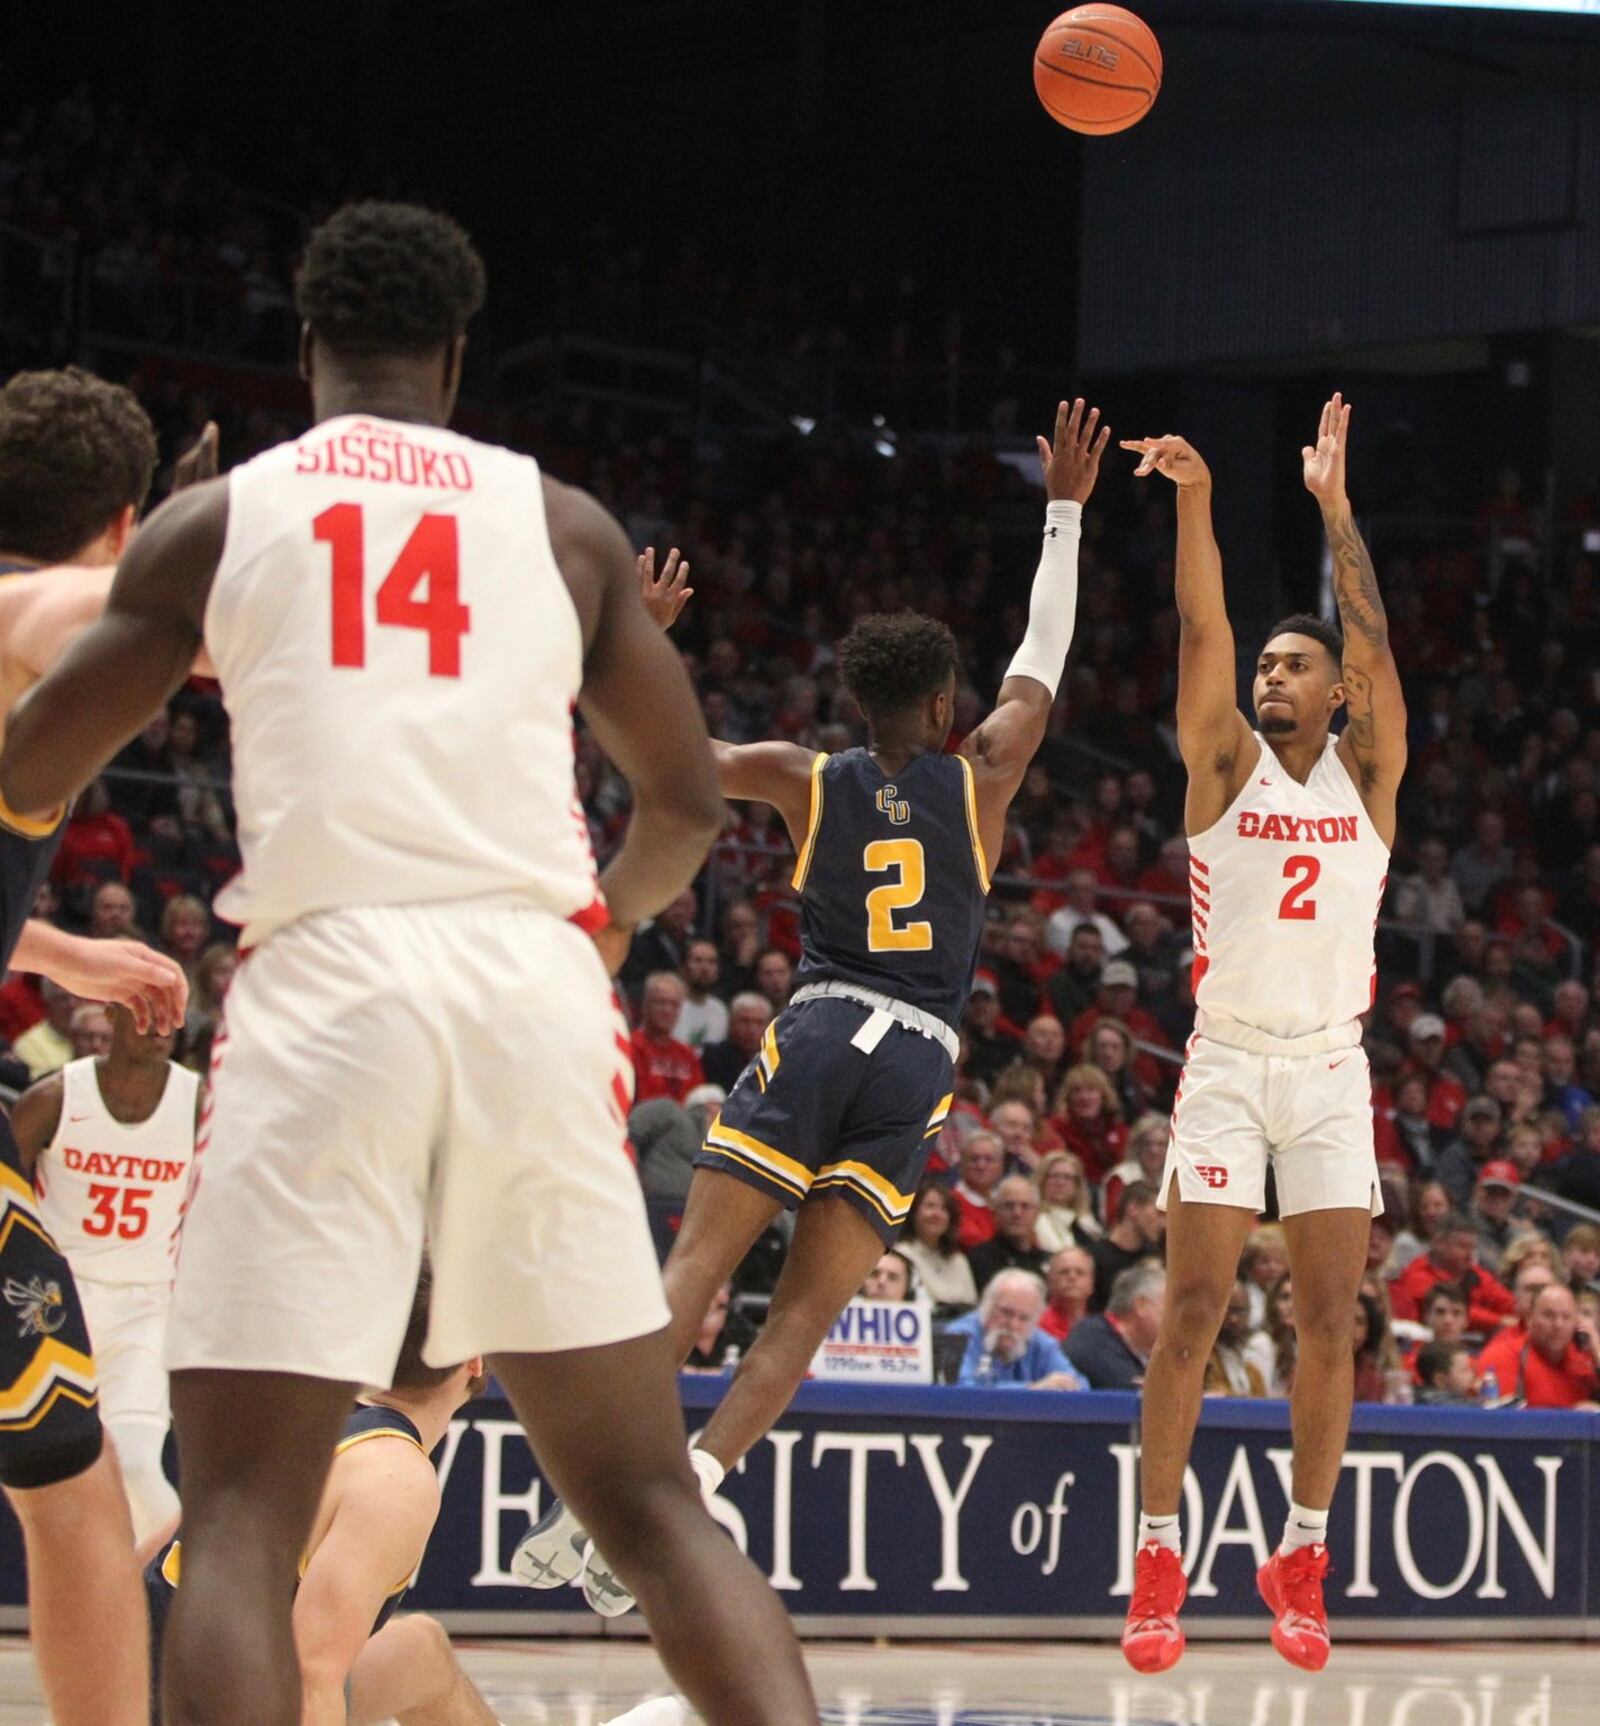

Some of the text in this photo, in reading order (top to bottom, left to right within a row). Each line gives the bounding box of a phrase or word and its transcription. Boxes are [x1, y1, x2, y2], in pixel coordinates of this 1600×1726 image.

[1061, 39, 1119, 67] ELITE
[296, 434, 474, 491] SISSOKO
[312, 502, 471, 678] 14
[1237, 811, 1358, 843] DAYTON
[864, 838, 933, 952] 2
[1278, 855, 1321, 920] 2
[63, 1148, 186, 1183] DAYTON
[82, 1183, 154, 1240] 35
[826, 1307, 920, 1343] WHIO
[1010, 1472, 1075, 1575] of
